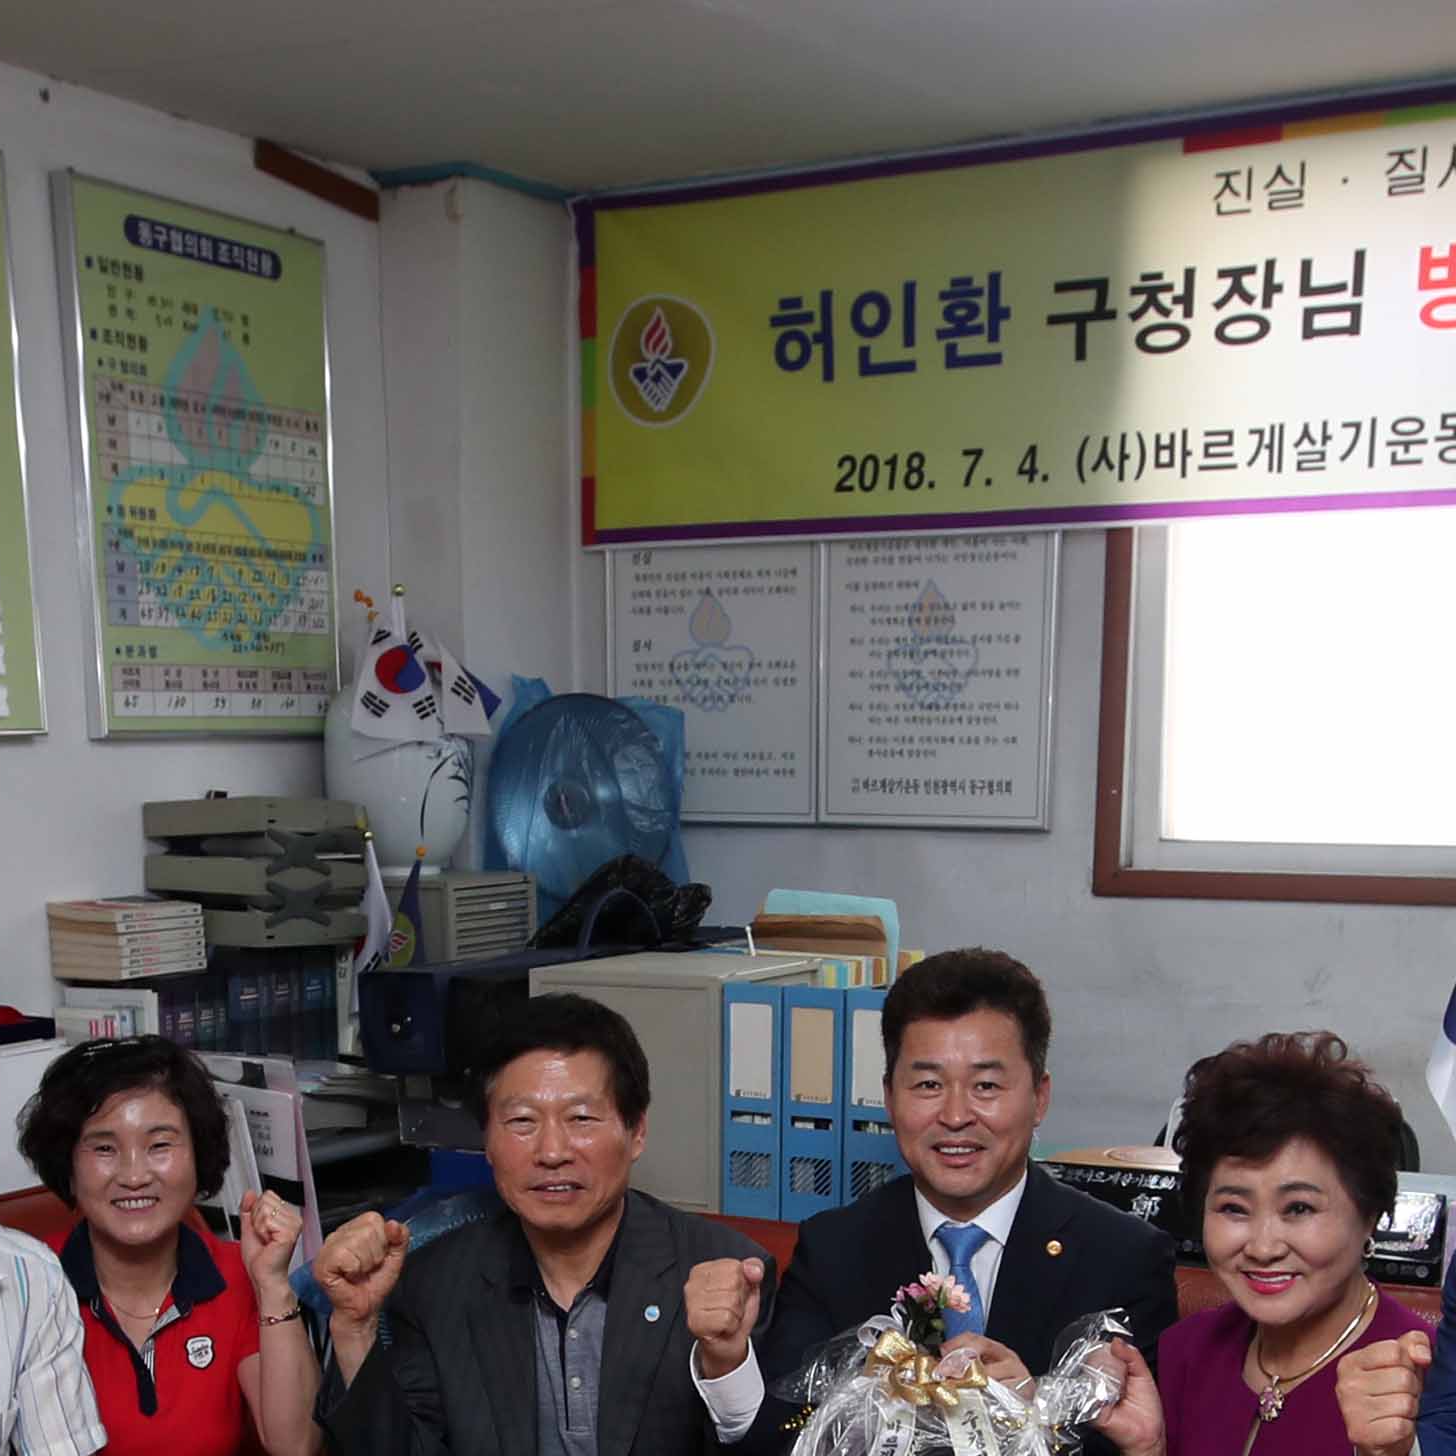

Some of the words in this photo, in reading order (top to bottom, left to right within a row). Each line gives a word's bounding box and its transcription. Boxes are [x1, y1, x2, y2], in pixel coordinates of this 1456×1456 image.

[1212, 160, 1308, 217] 진실
[768, 270, 1011, 383] 허인환
[1045, 248, 1367, 362] 구청장님
